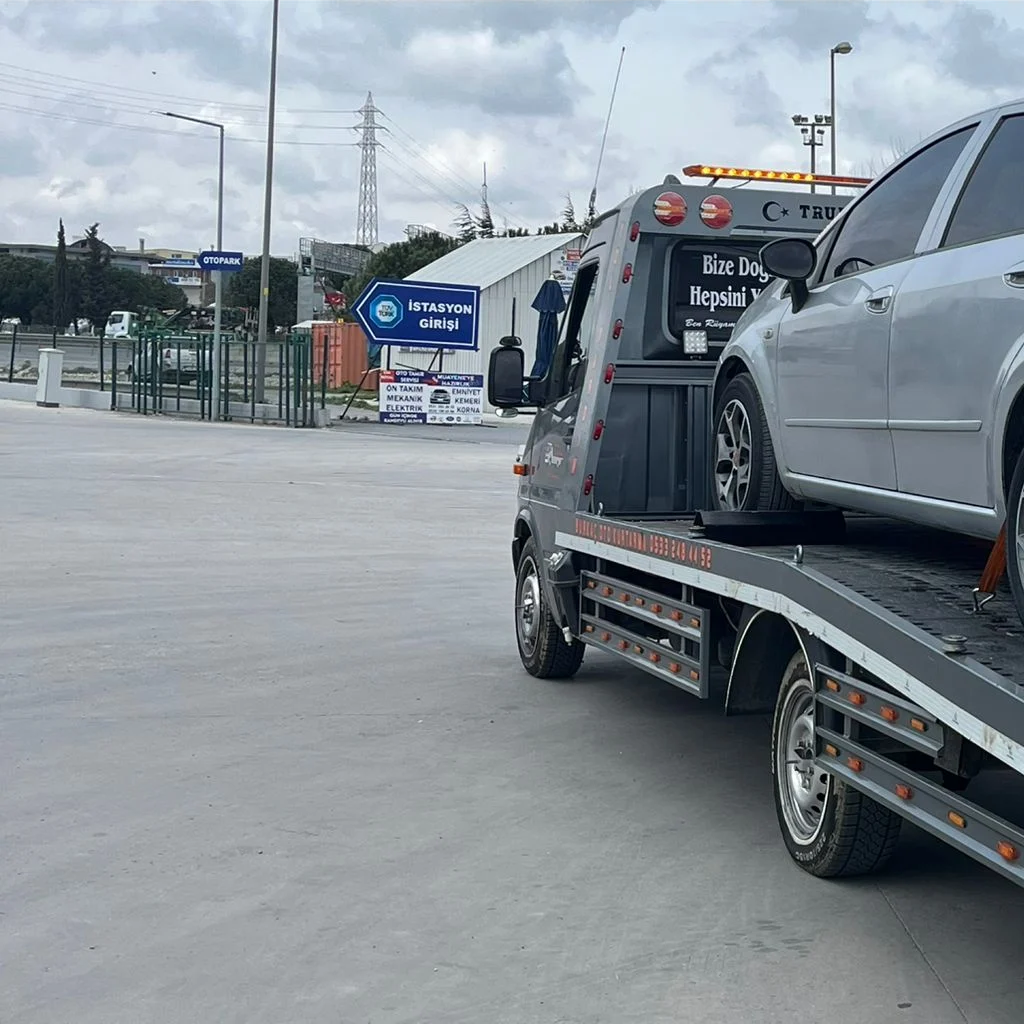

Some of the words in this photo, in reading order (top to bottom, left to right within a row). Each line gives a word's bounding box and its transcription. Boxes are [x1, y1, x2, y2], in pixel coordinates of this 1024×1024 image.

[203, 256, 241, 265] OTOPARK
[702, 253, 735, 276] Bize
[408, 299, 472, 314] İSTASYON
[690, 285, 747, 312] Hepsini
[419, 317, 459, 331] GİRİŞİ
[701, 546, 712, 569] 52
